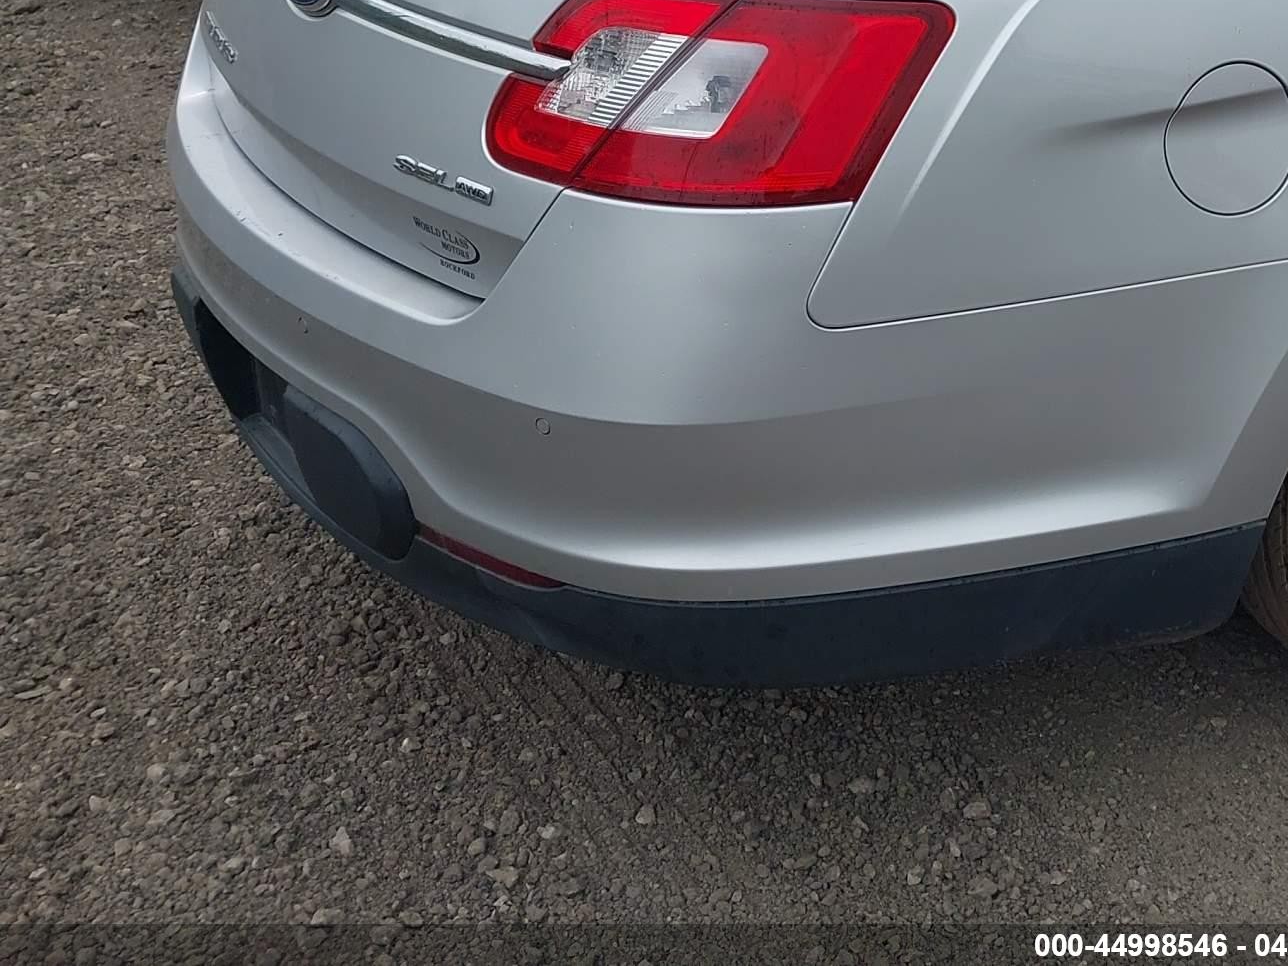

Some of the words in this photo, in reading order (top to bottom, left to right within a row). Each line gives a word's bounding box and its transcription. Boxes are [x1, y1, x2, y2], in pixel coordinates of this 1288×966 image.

[393, 154, 455, 192] SEL
[457, 180, 490, 203] AWD
[413, 216, 441, 237] WORLD
[442, 229, 469, 250] CLASS
[441, 241, 470, 259] MOTORS
[440, 259, 475, 280] ROCKFORD
